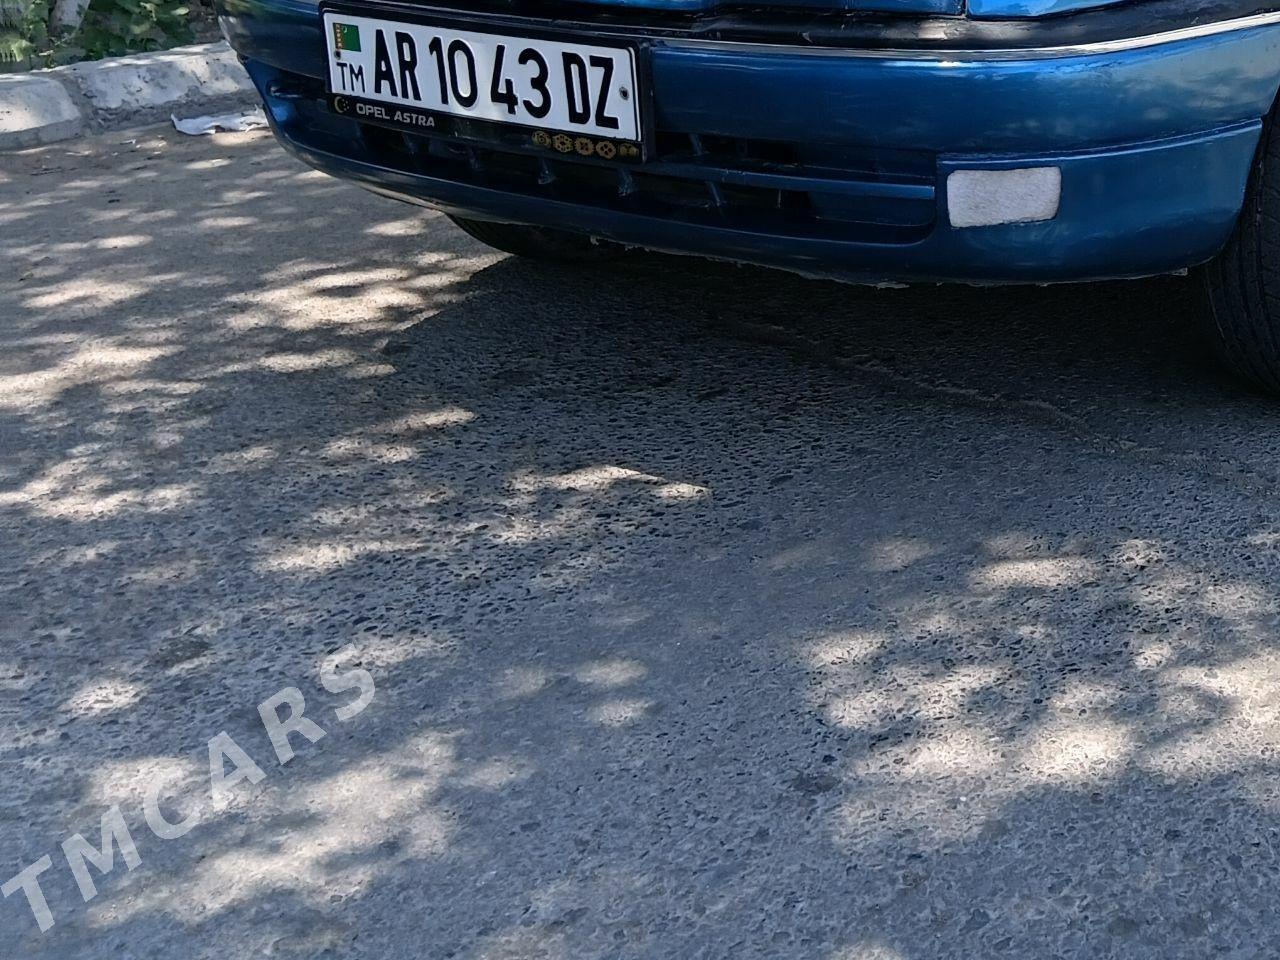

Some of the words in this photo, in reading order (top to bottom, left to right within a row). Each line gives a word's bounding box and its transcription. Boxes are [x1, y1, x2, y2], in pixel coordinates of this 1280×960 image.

[336, 62, 366, 94] TM
[374, 28, 422, 102] AR
[429, 36, 479, 109] 10
[490, 44, 552, 119] 43
[562, 51, 620, 130] DZ
[356, 103, 390, 121] OPEL
[394, 111, 436, 128] ASTRA
